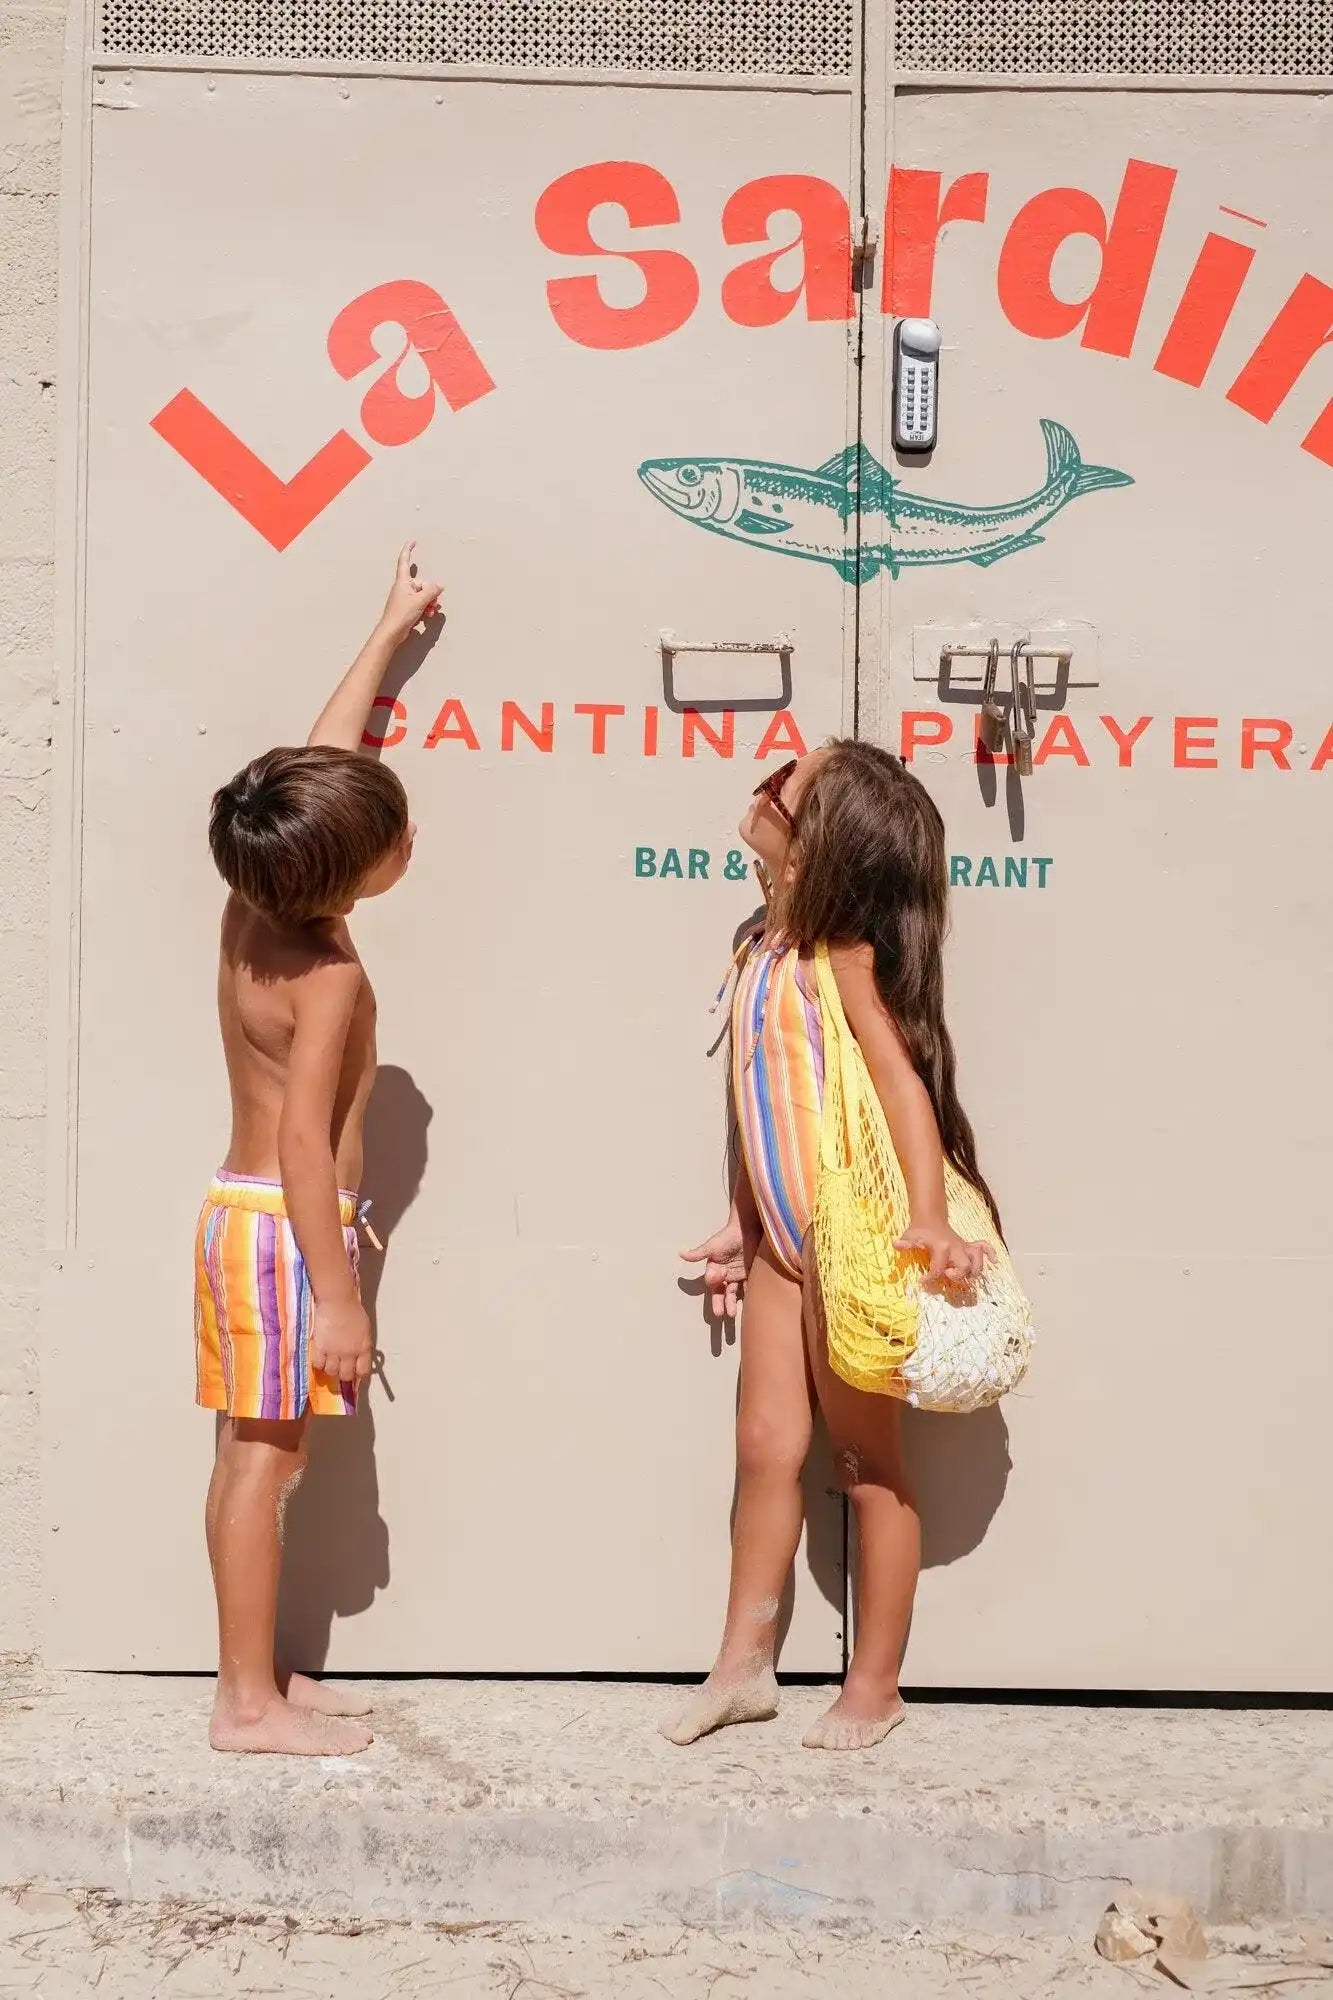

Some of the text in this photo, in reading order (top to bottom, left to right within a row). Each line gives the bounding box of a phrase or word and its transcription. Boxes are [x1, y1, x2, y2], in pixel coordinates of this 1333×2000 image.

[149, 279, 495, 552] La
[360, 696, 809, 761] CANTINA
[635, 847, 710, 879] BAR
[722, 850, 748, 881] &
